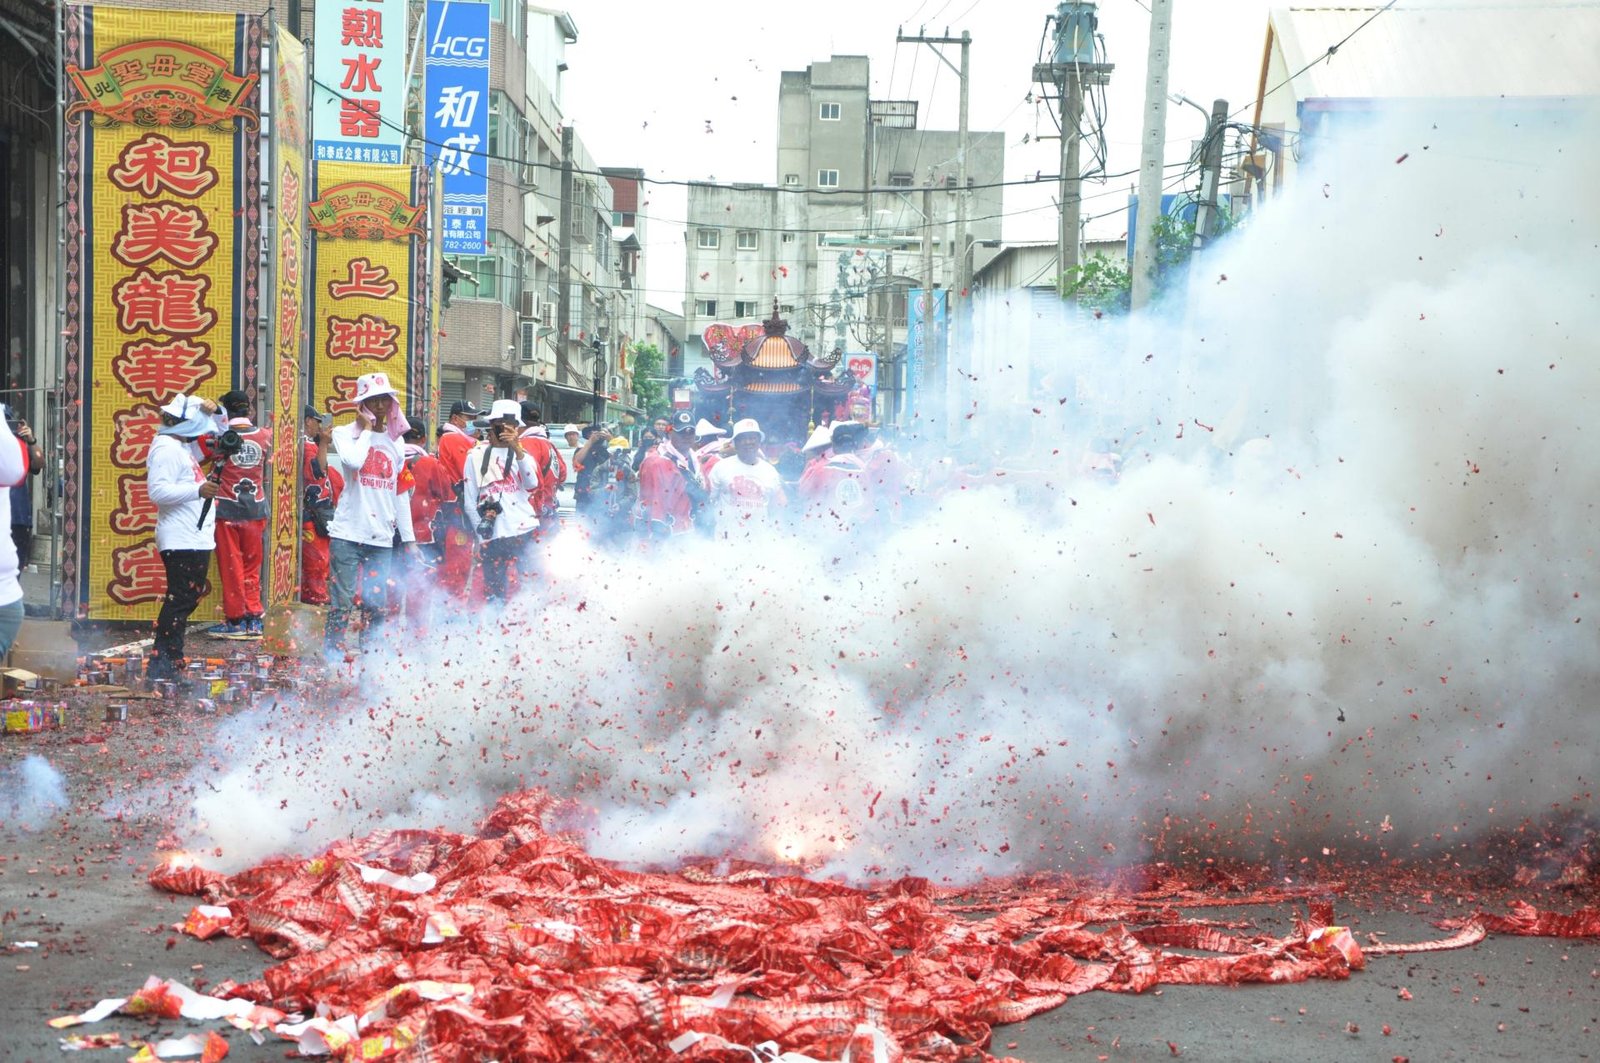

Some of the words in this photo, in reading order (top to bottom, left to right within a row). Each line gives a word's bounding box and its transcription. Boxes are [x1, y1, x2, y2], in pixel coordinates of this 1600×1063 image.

[111, 54, 216, 88] 聖母堂
[434, 85, 481, 176] 和成
[317, 144, 398, 162] 和泰成企業有限公司
[329, 191, 398, 215] 聖母堂
